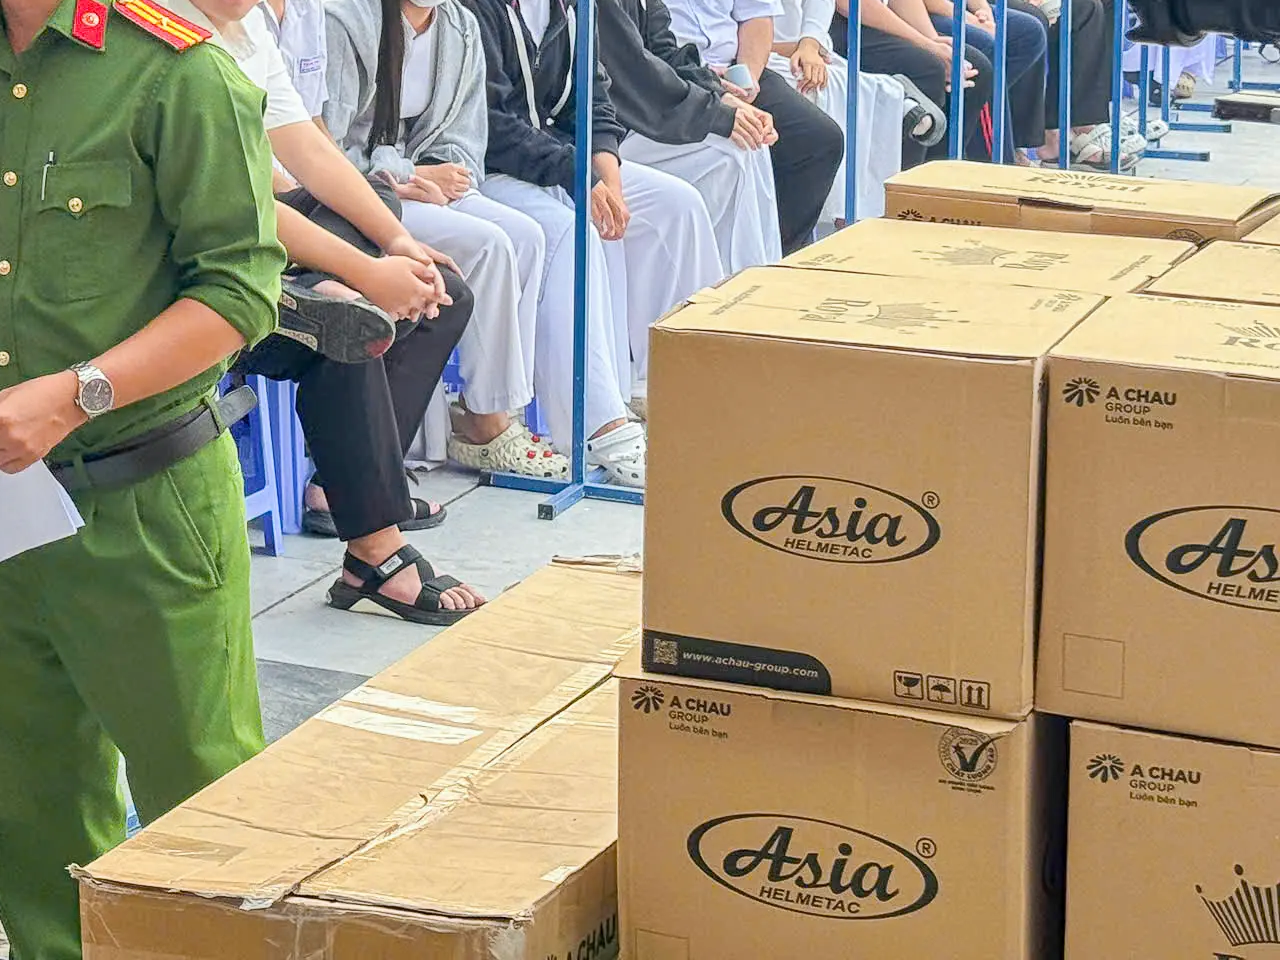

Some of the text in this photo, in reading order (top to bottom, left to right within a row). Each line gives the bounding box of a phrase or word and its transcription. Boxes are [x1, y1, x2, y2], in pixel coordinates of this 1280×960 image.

[1106, 386, 1177, 406] A CHAU
[1105, 402, 1151, 415] GROUP
[1133, 416, 1151, 427] bên
[752, 486, 907, 547] Asia
[783, 537, 873, 559] HELMETAC
[682, 650, 818, 679] www.achau-group.com
[669, 710, 709, 724] GROUP
[670, 697, 731, 717] A CHAU
[1130, 765, 1202, 784] A CHAU
[1129, 780, 1175, 793] GROUP
[723, 826, 899, 901] Asia
[759, 885, 862, 914] HELMETAC
